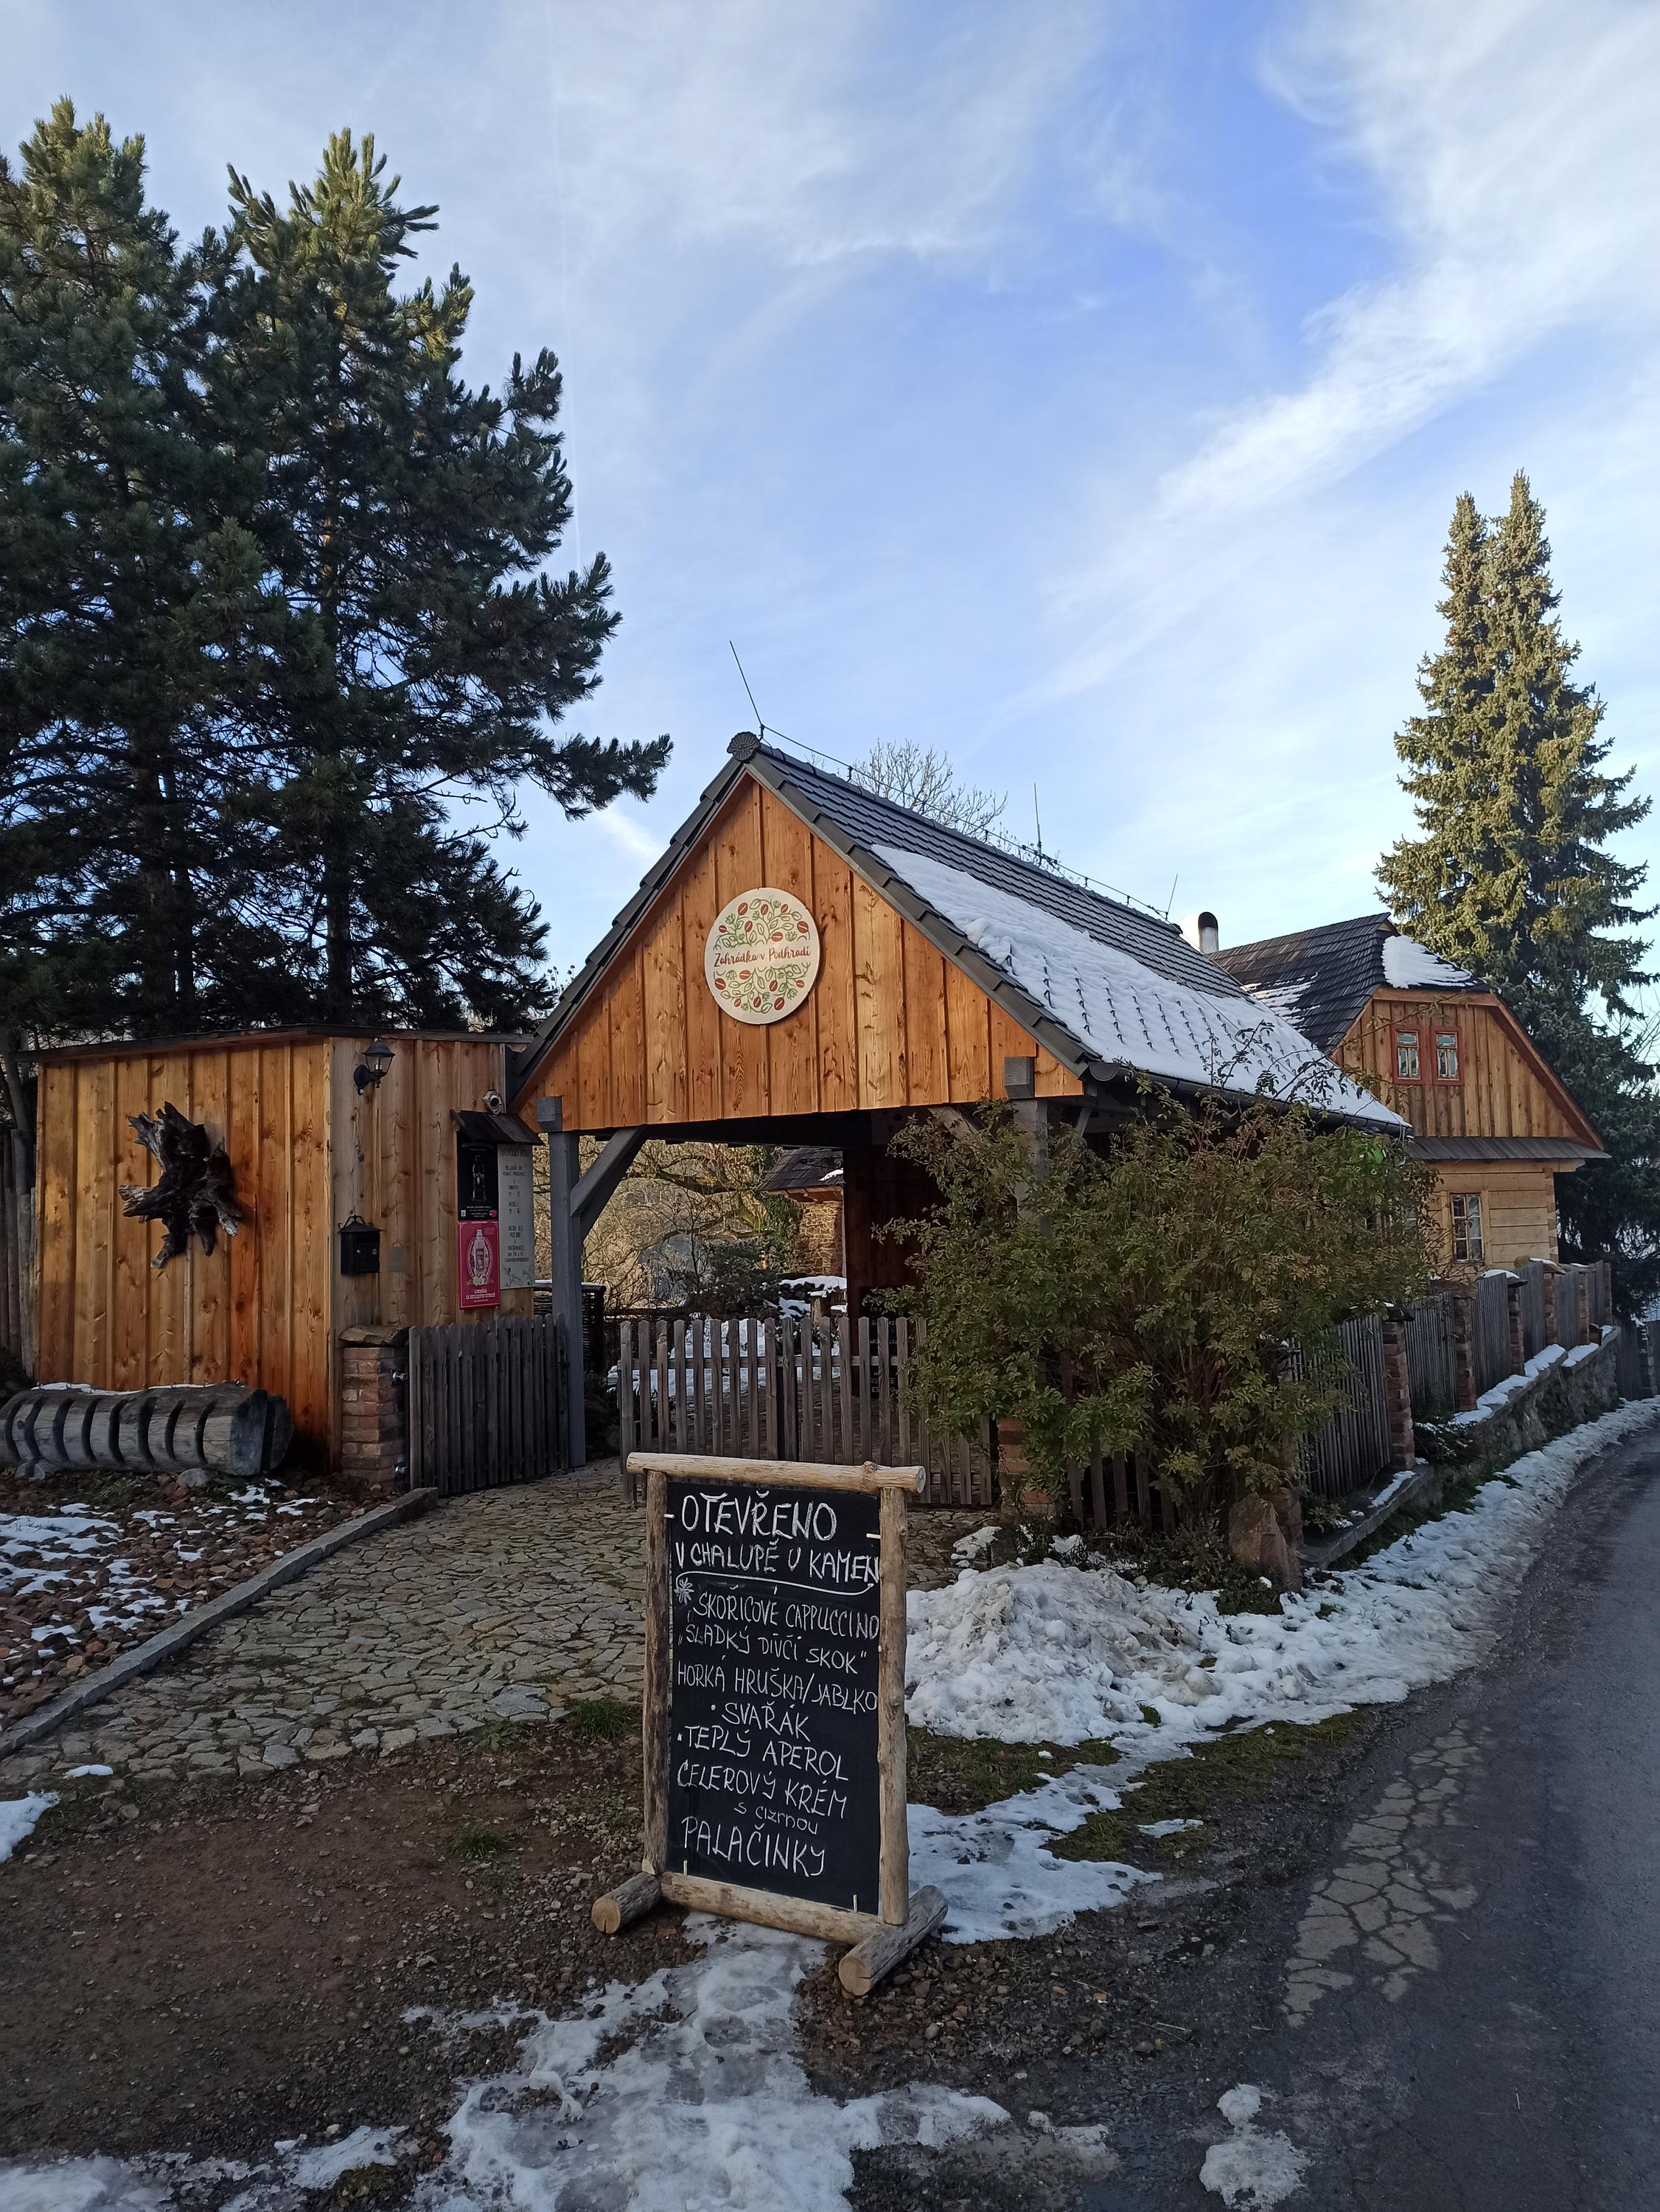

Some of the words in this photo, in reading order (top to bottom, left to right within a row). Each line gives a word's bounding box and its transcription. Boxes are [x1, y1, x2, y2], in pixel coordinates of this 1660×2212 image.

[714, 950, 758, 967] Zahrádka
[769, 945, 811, 961] Podhradí
[682, 1489, 837, 1541] OTEVŘENO
[675, 1542, 684, 1569] V
[691, 1537, 781, 1572] CHALUPĚ
[788, 1547, 801, 1571] U
[693, 1585, 779, 1625] SKOŘICOVÉ
[786, 1604, 879, 1640] CAPPUCCINO
[678, 1655, 725, 1692] HORKÁ
[721, 1700, 811, 1742] SVAŘÁK
[685, 1725, 751, 1758] TEPLÝ
[761, 1741, 848, 1781] APEROL
[677, 1759, 776, 1799] CELEROVÝ
[785, 1778, 847, 1819] KRÉM
[681, 1816, 826, 1877] PALAČINKY
